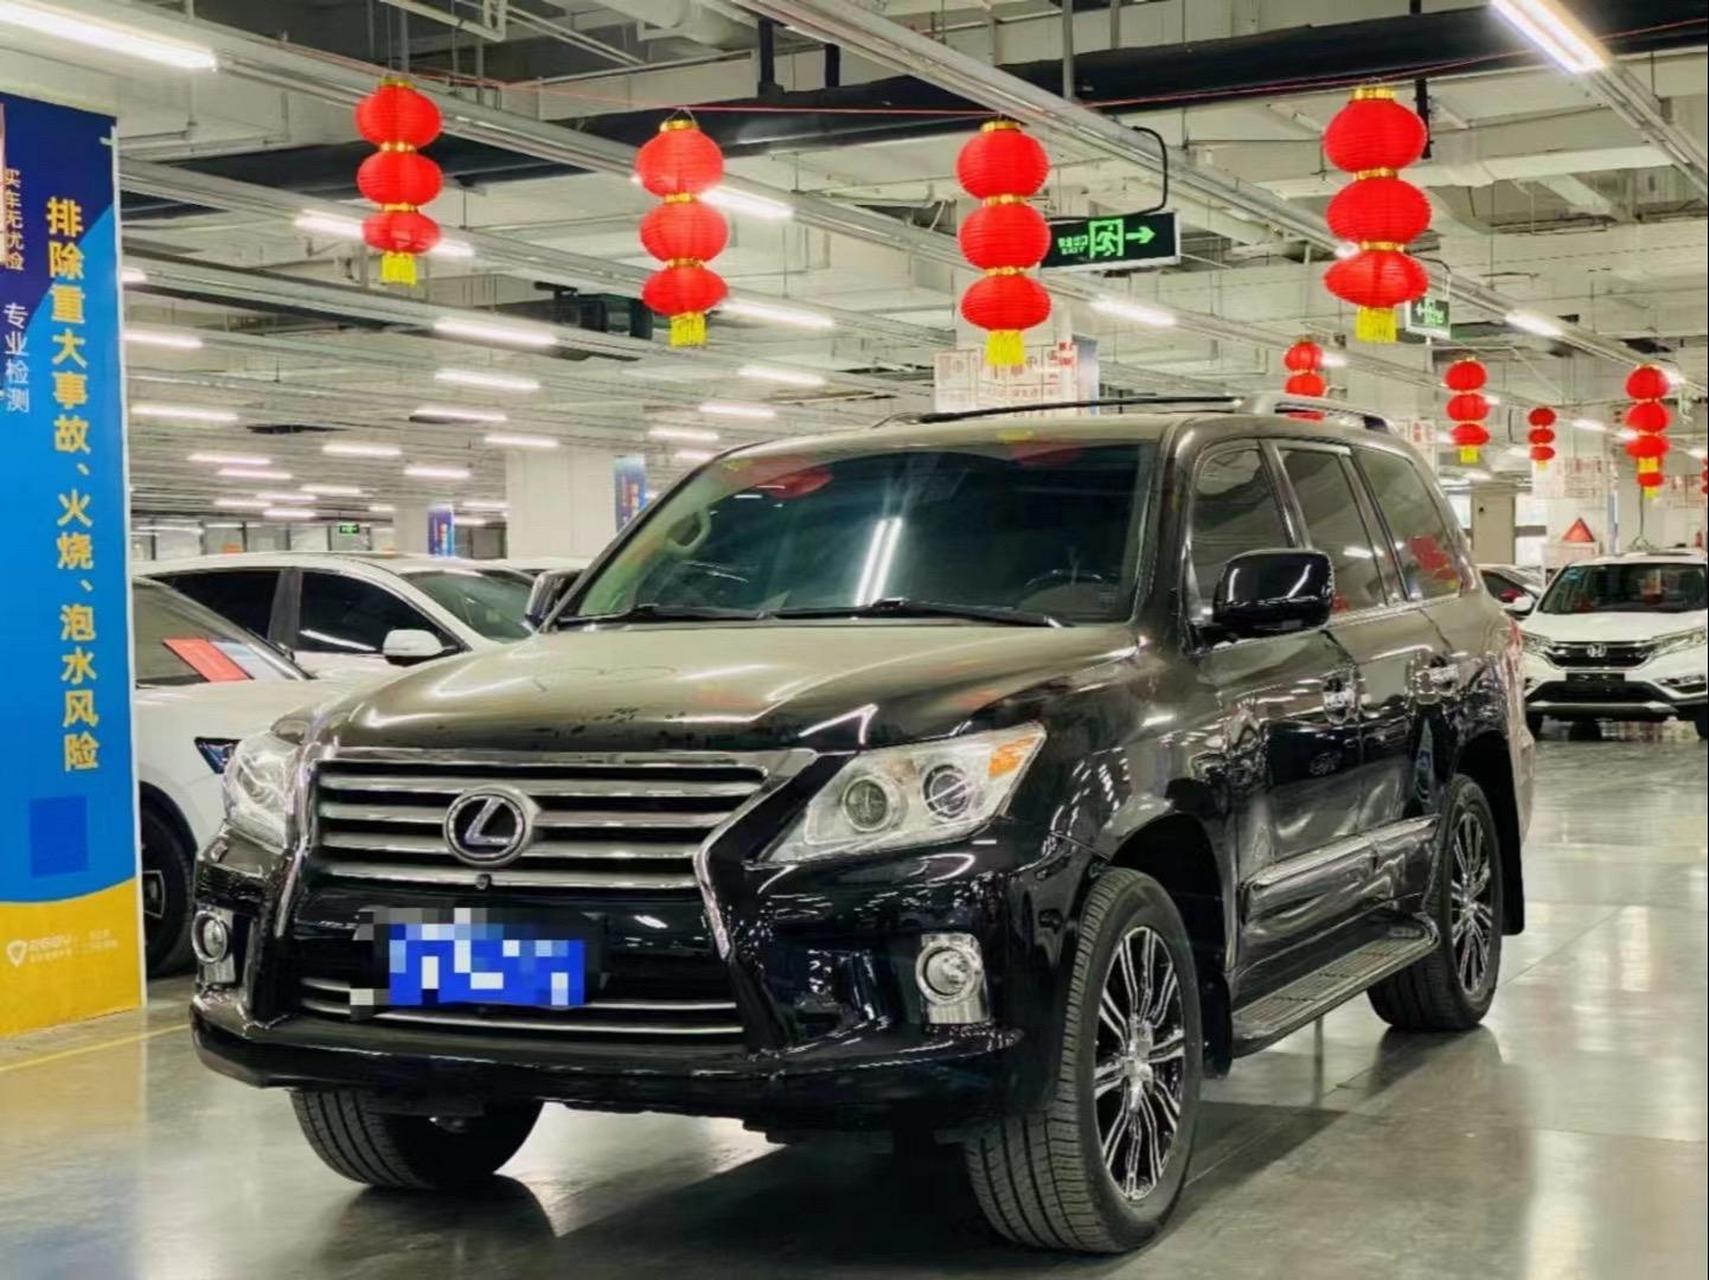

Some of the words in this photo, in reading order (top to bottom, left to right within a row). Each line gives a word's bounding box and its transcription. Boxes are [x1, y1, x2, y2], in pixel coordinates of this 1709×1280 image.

[3, 302, 29, 413] 专业检测
[46, 195, 99, 772] 排除重大事故、火烧、泡水风险
